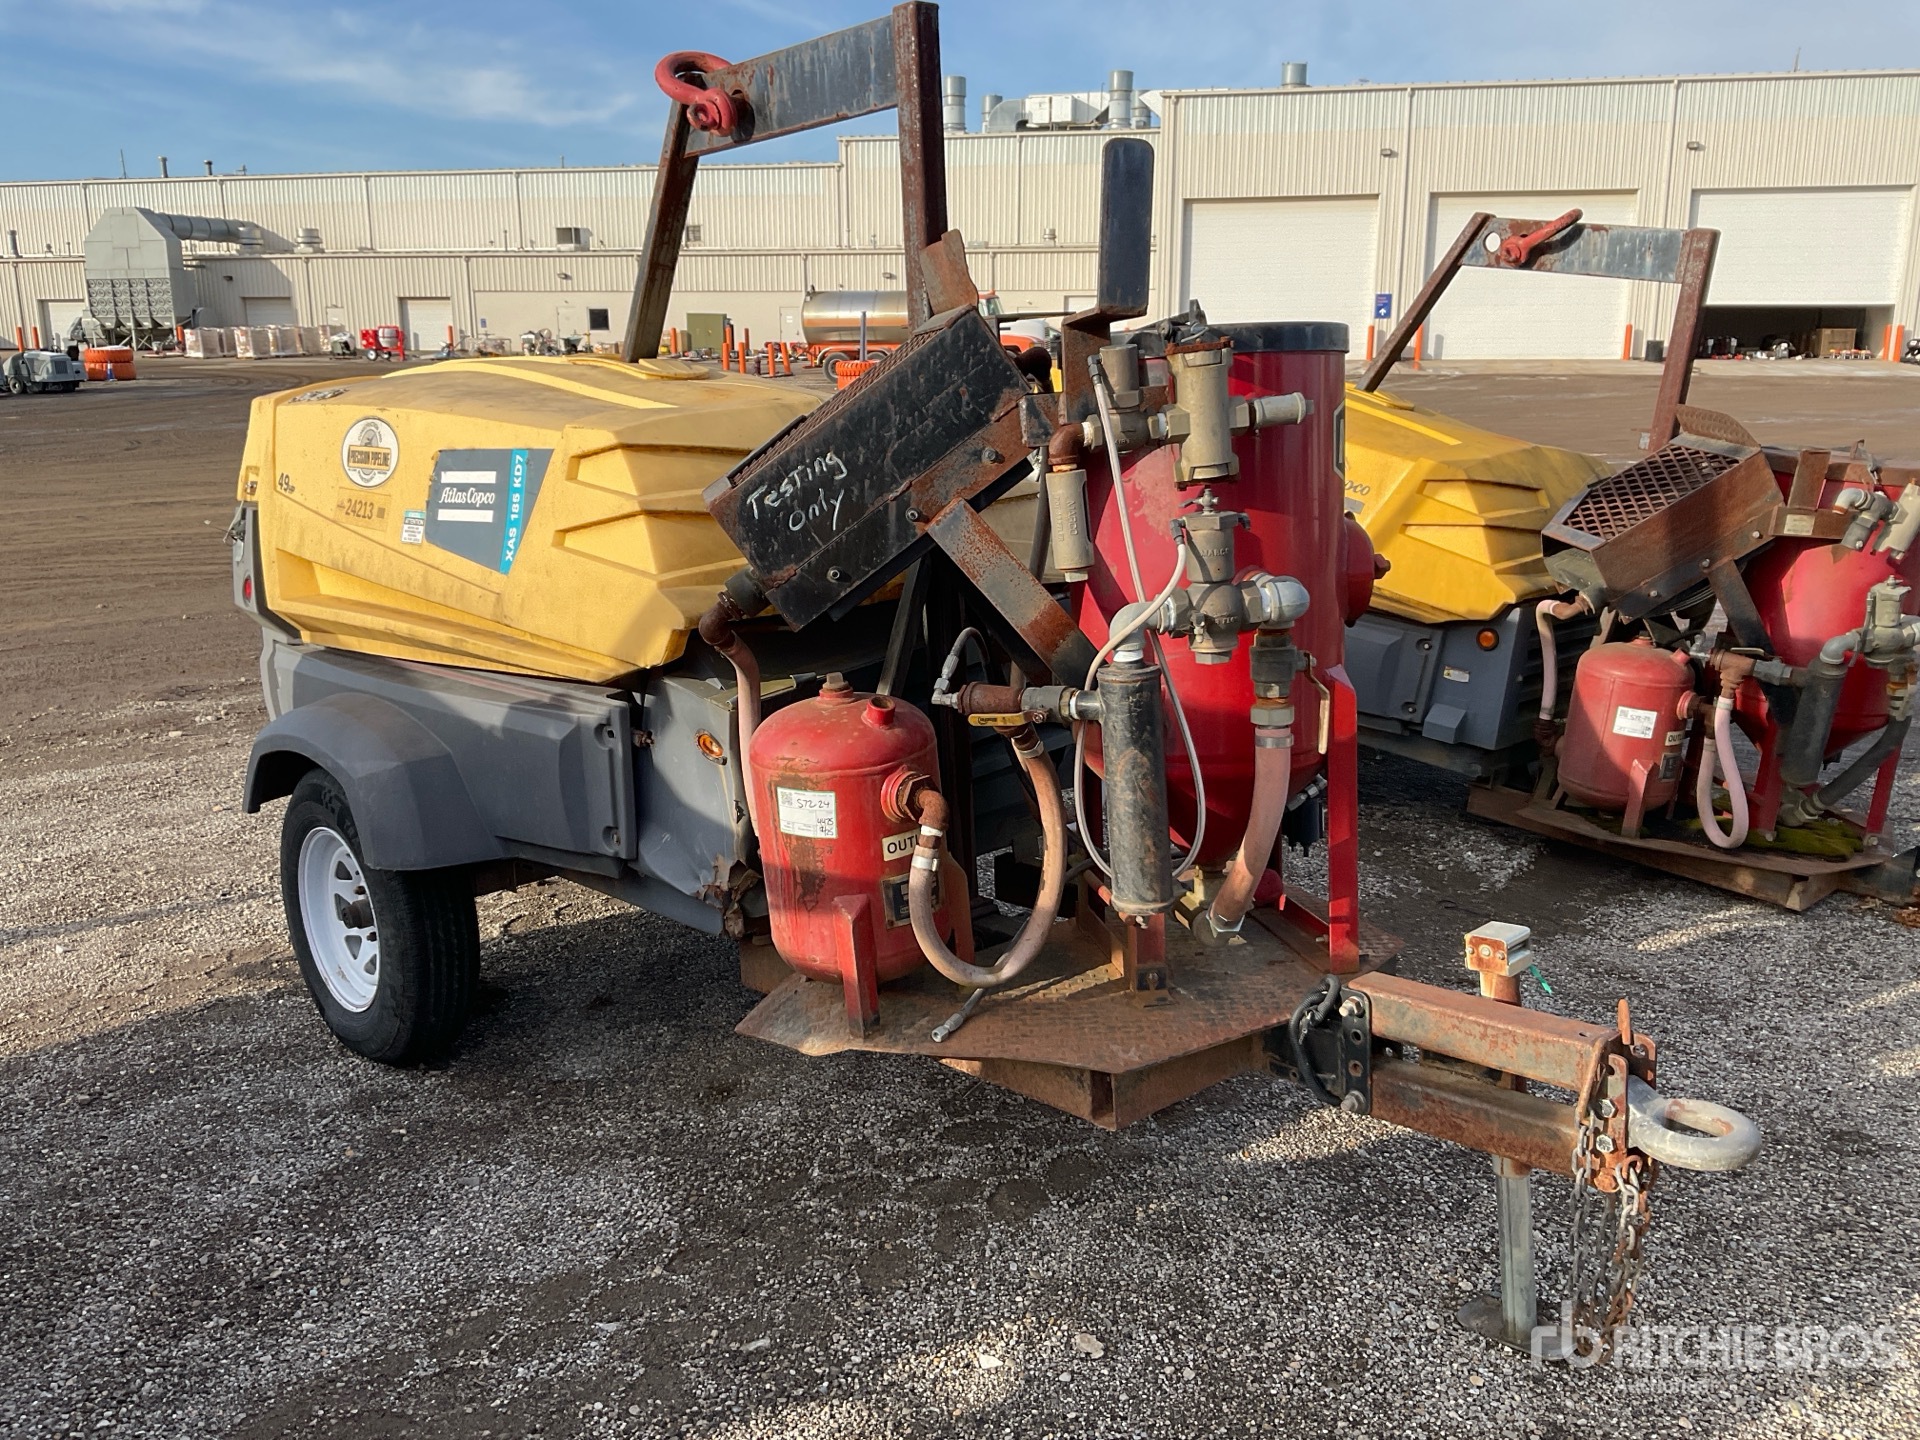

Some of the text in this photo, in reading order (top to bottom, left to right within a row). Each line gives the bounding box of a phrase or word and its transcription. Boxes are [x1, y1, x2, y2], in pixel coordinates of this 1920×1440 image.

[439, 487, 496, 508] Atlas Copco
[505, 454, 524, 562] XAS 185 KD7
[345, 498, 375, 520] 24213
